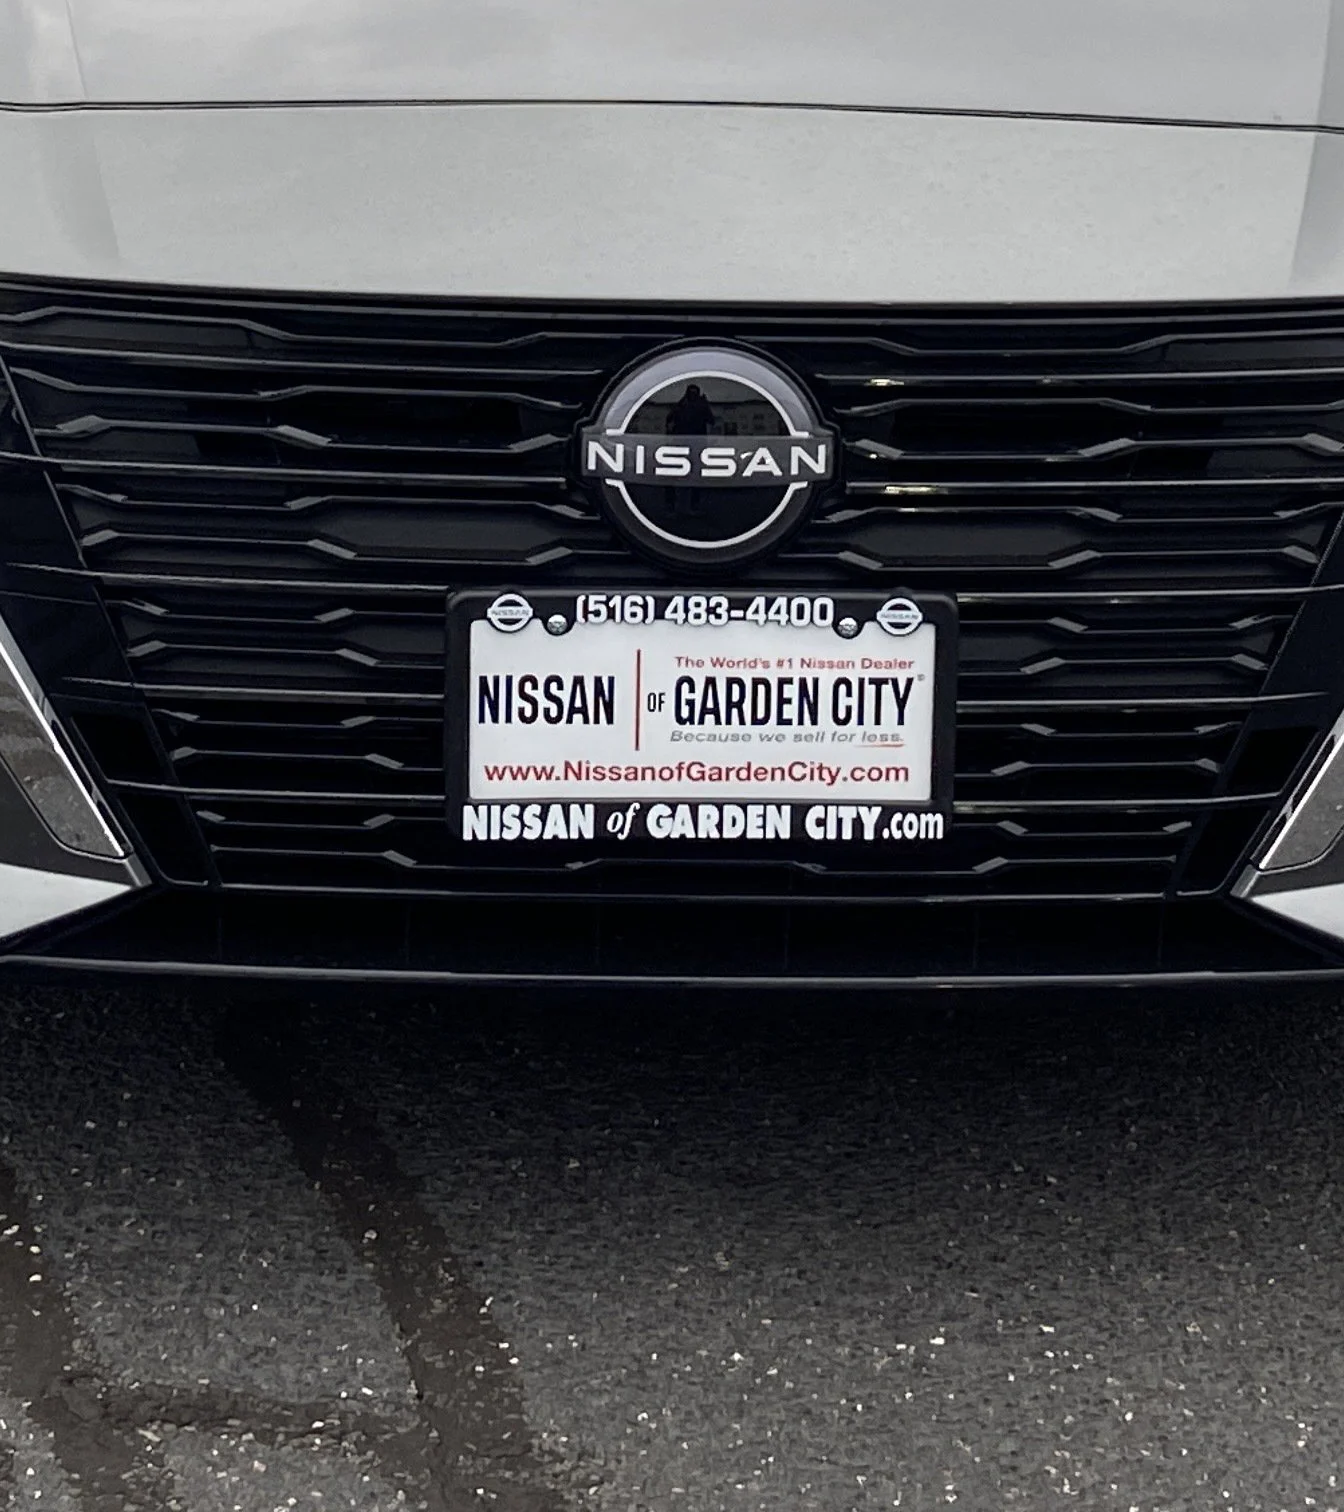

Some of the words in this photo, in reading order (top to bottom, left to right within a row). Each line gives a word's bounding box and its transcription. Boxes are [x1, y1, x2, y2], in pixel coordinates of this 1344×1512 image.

[587, 440, 826, 477] NISSAN
[575, 594, 655, 625] (516)
[664, 594, 835, 628] 483-4400
[674, 656, 705, 669] The
[710, 657, 770, 669] World's
[776, 658, 793, 669] #1
[800, 658, 855, 669] Nissan
[861, 658, 915, 670] Dealer
[478, 674, 615, 725] NISSAN
[647, 692, 666, 712] OF
[674, 675, 819, 726] GARDEN
[832, 676, 915, 726] CITY
[669, 730, 752, 742] Because
[758, 733, 783, 742] we
[793, 731, 826, 743] sell
[830, 731, 857, 743] for
[484, 759, 910, 786] www.NissanofGardenCity.com
[462, 803, 595, 840] NISSAN
[606, 802, 641, 840] of
[646, 803, 791, 840] GARDEN
[805, 804, 944, 840] CITY.com
